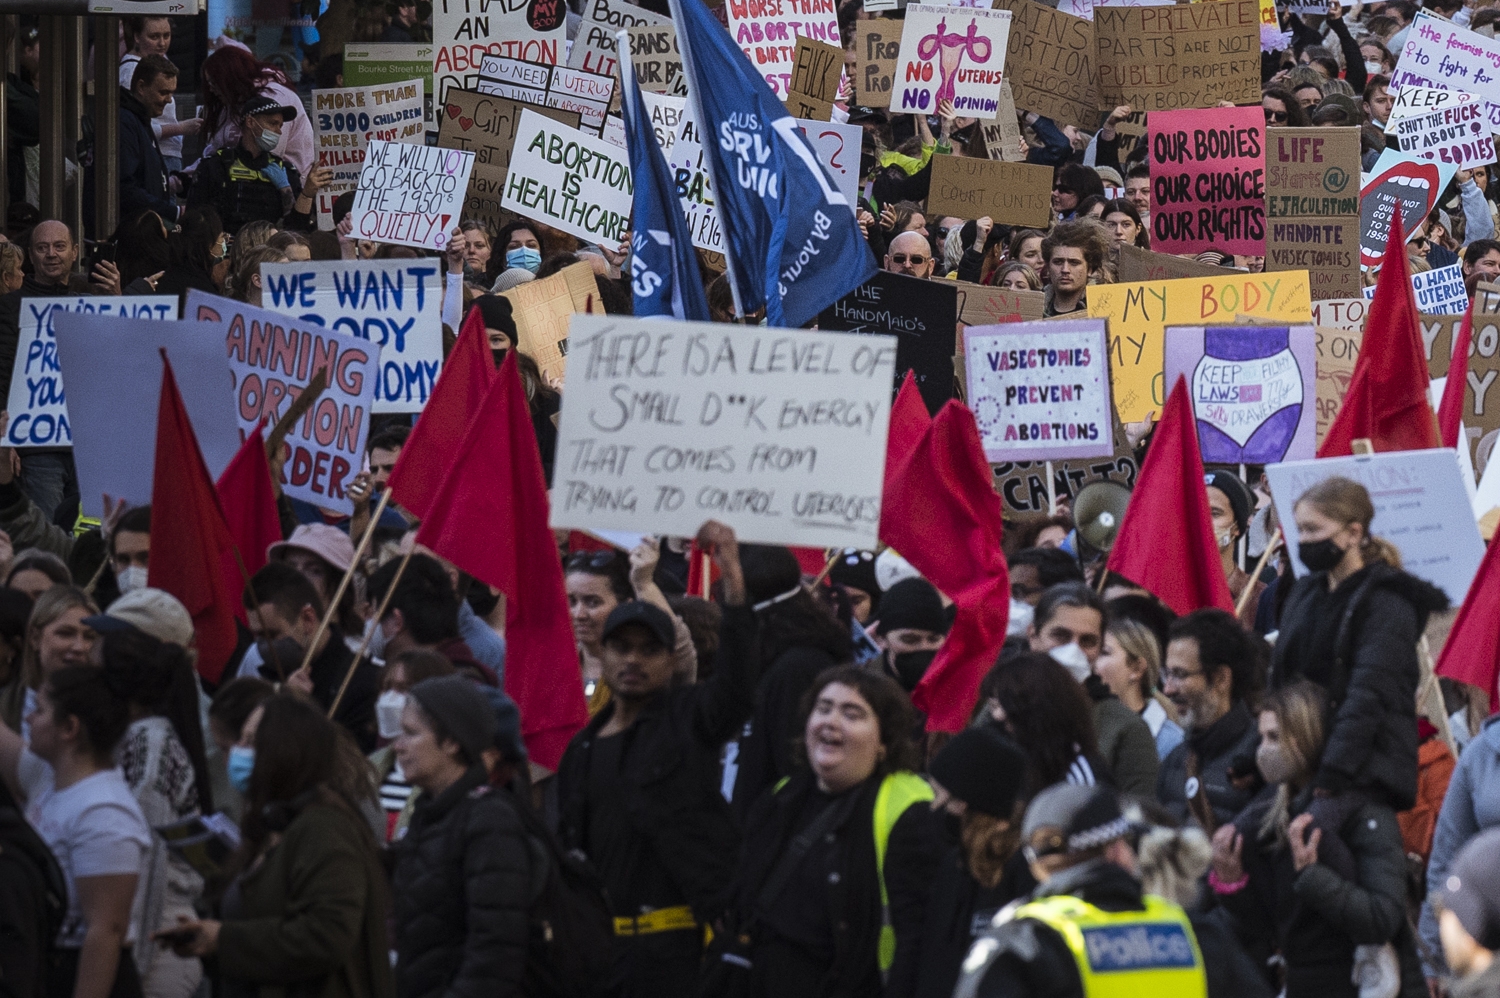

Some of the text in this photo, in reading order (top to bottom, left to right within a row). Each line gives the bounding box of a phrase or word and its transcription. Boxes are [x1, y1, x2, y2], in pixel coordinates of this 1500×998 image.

[454, 17, 489, 40] AN
[1096, 9, 1126, 32] MY
[1100, 36, 1175, 57] PARTS
[1419, 24, 1442, 44] the
[359, 65, 387, 73] Bourke
[513, 66, 611, 97] NEED UTERUS
[906, 61, 1002, 84] NO UTERUS
[317, 84, 418, 110] MORE THAN
[902, 88, 998, 112] NO OPINION
[1397, 90, 1450, 107] KEEP
[318, 107, 423, 132] 3000 CHILDREN
[1444, 103, 1482, 125] FUCK
[1154, 125, 1261, 164] OUR BODIES
[1422, 125, 1467, 148] ABOUT
[1278, 137, 1324, 164] LIFE
[1440, 137, 1494, 163] BODIES
[1154, 168, 1265, 205] OUR CHOICE
[506, 173, 630, 242] HEALTHCARE
[1269, 196, 1358, 217] EJACULATION
[1154, 205, 1265, 242] OUR RIGHTS
[1273, 224, 1343, 244] MANDATE
[1271, 250, 1351, 267] VASECTOMIES
[267, 267, 438, 313] WE WANT
[1122, 278, 1281, 323] MY BODY
[749, 336, 840, 375] LEVEL
[986, 347, 1092, 372] VASECTOMIES
[1005, 385, 1084, 406] PREVENT
[778, 399, 880, 432] ENERGY
[1004, 423, 1099, 442] ABORTIONS
[570, 439, 817, 477] THAT COMES FROM
[564, 480, 781, 517] TRYING CONTROL
[1087, 928, 1193, 966] Police
